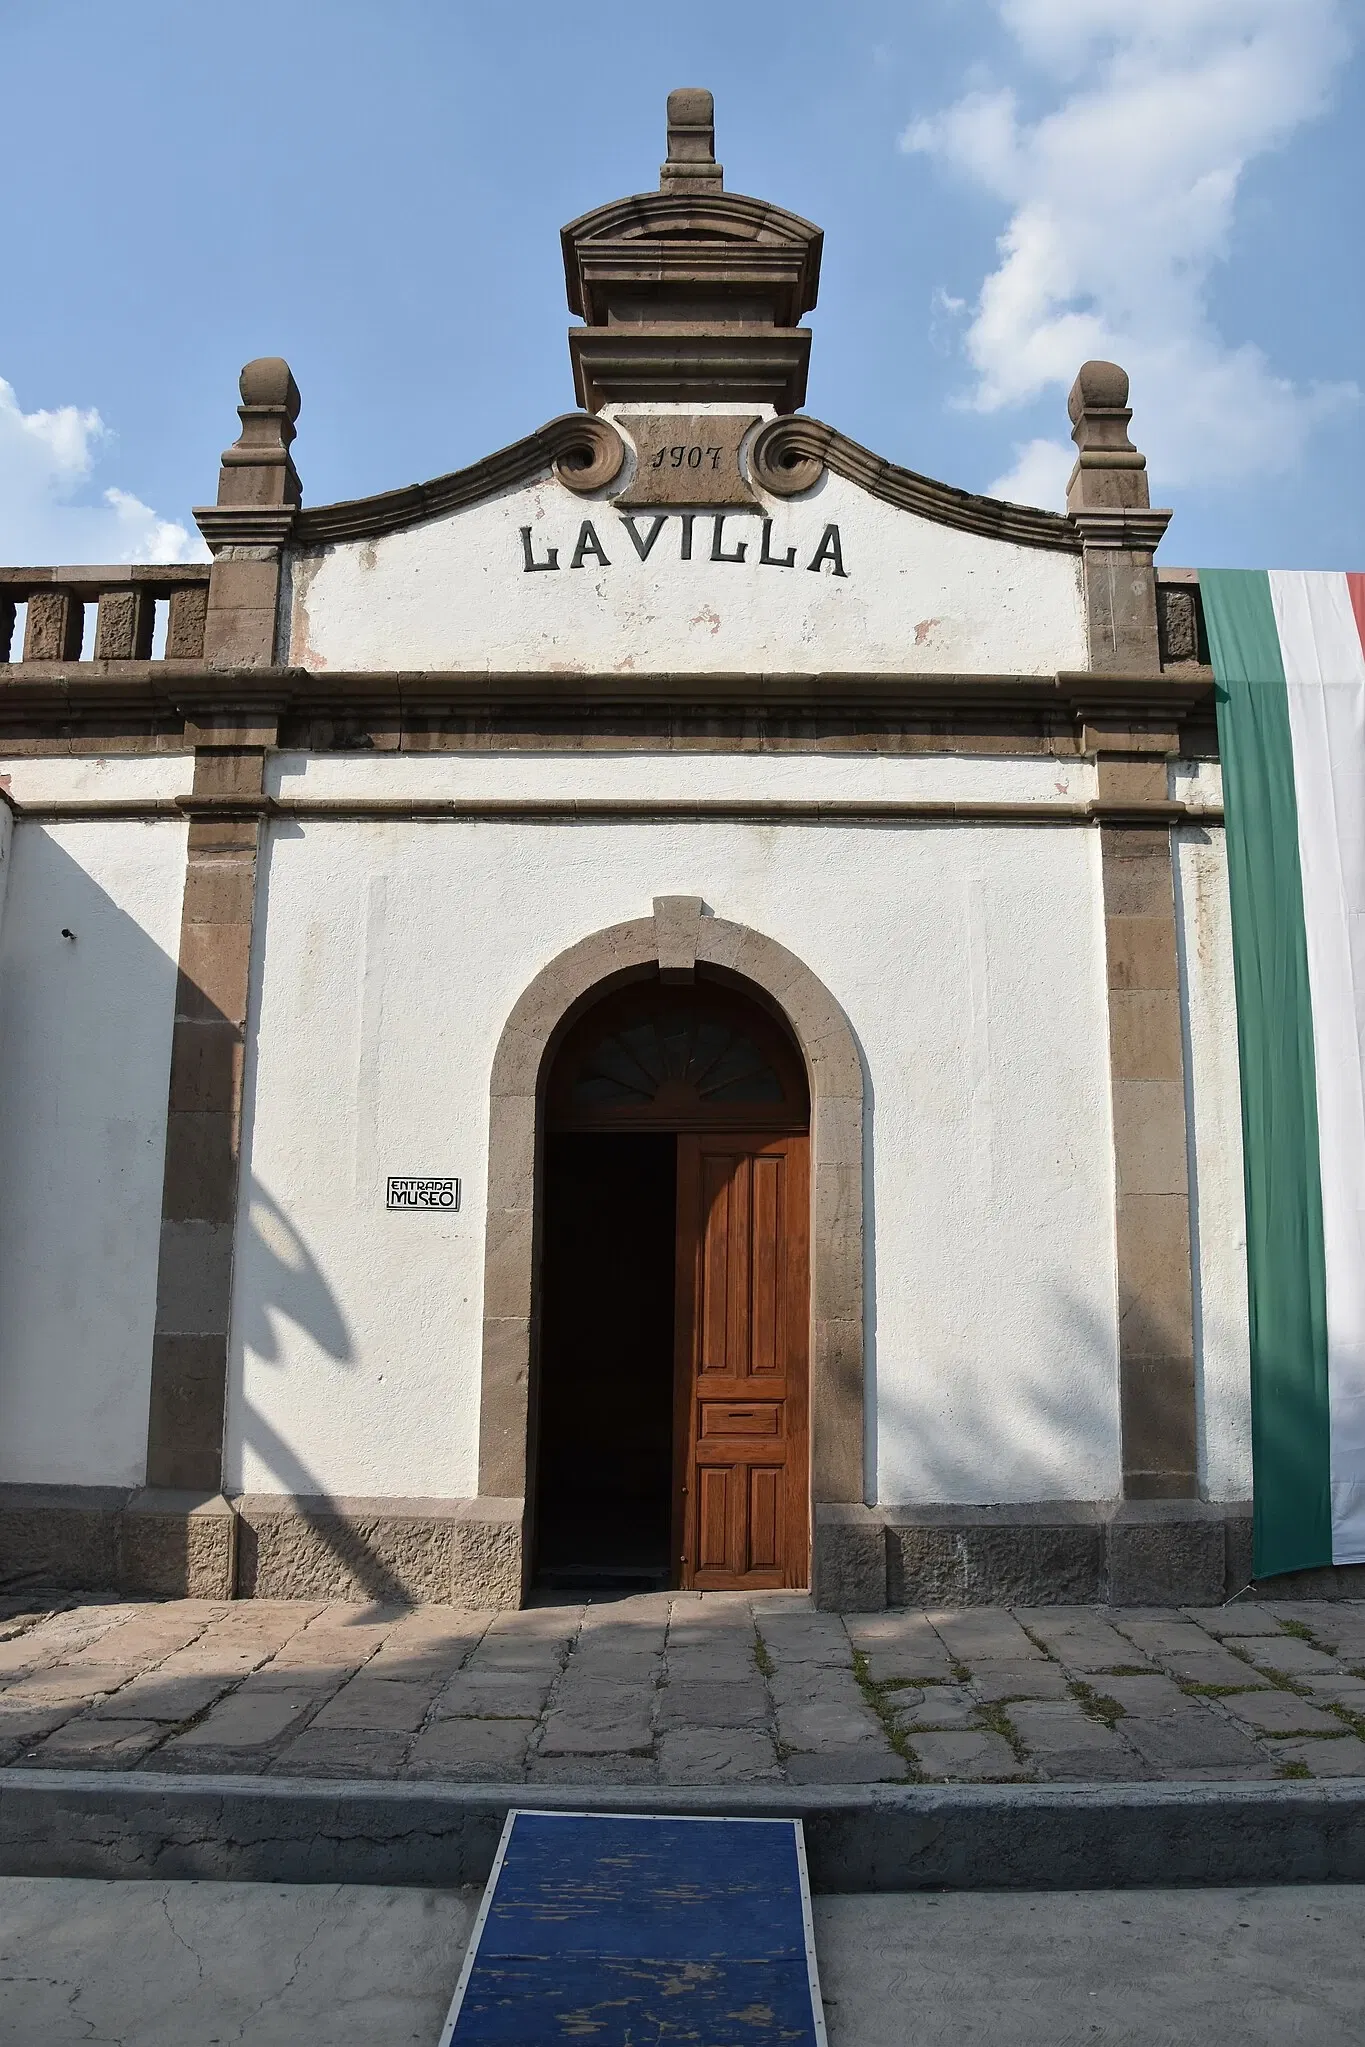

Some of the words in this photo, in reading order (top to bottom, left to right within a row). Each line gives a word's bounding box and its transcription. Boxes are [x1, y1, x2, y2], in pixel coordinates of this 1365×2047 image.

[653, 446, 723, 469] 1907
[519, 519, 612, 573] LA
[618, 514, 848, 578] VILLA
[391, 1181, 453, 1191] ENTRADA
[391, 1191, 454, 1206] MUSEO
